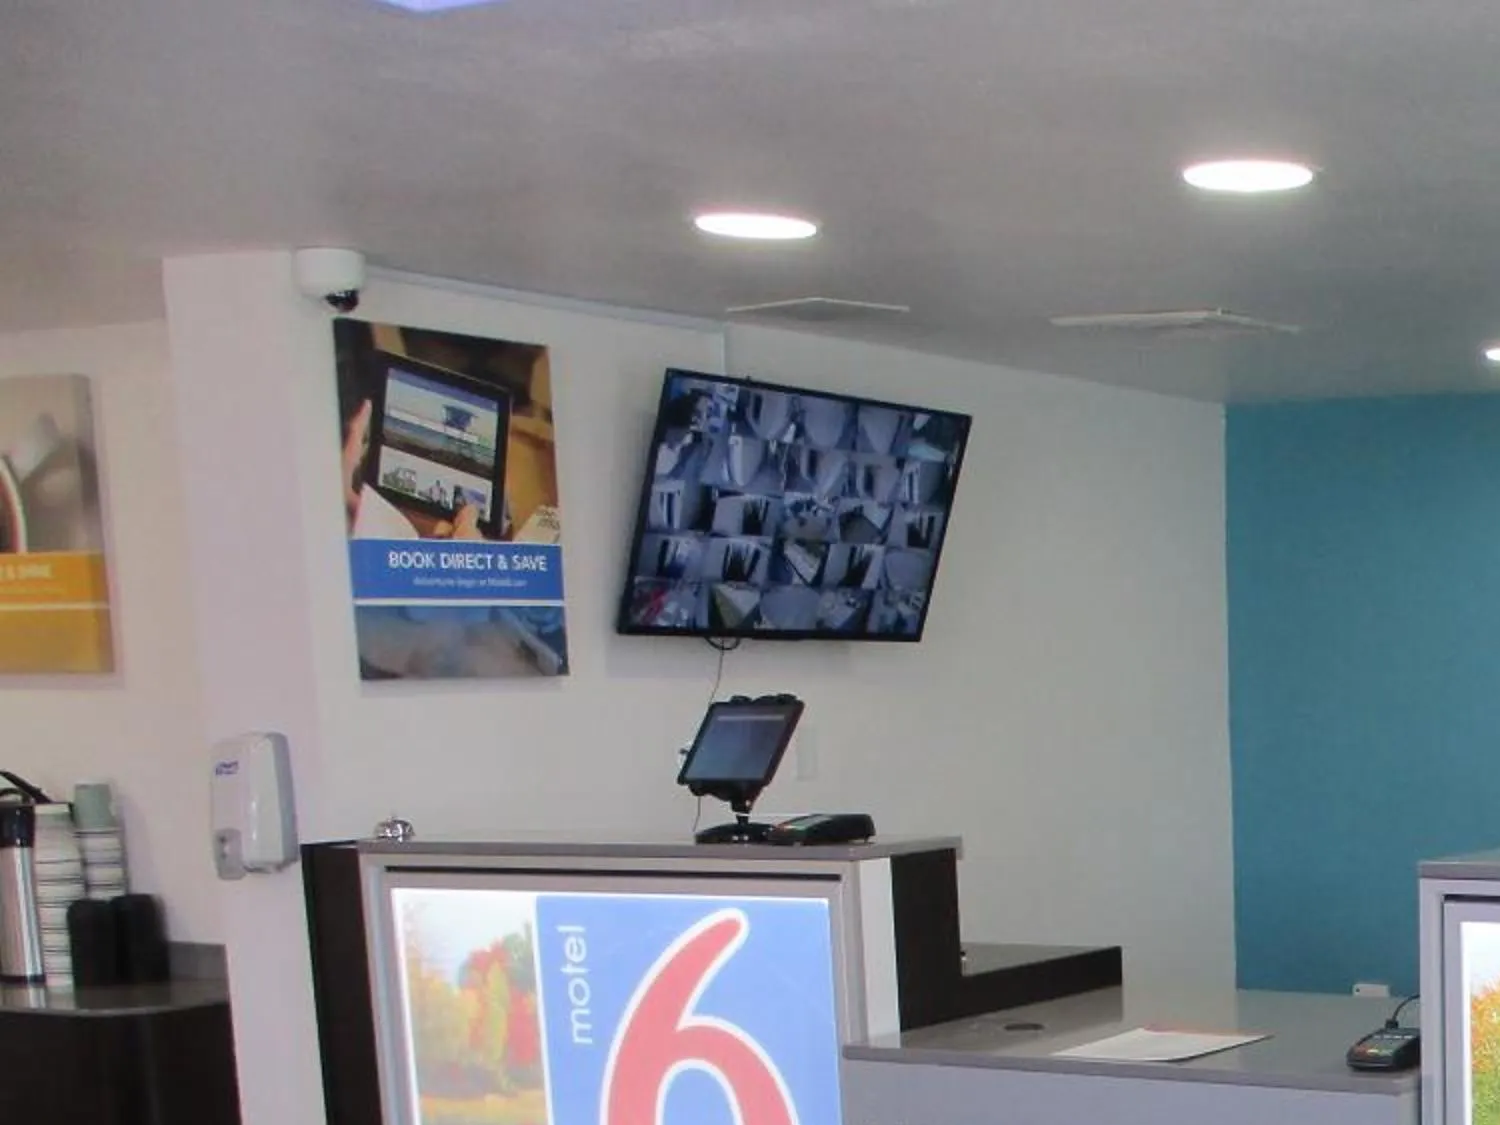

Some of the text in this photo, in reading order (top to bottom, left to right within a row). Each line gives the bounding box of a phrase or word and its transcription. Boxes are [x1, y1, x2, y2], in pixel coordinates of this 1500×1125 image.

[388, 551, 548, 572] BOOK DIRECT & SAVE
[557, 924, 593, 1045] motel
